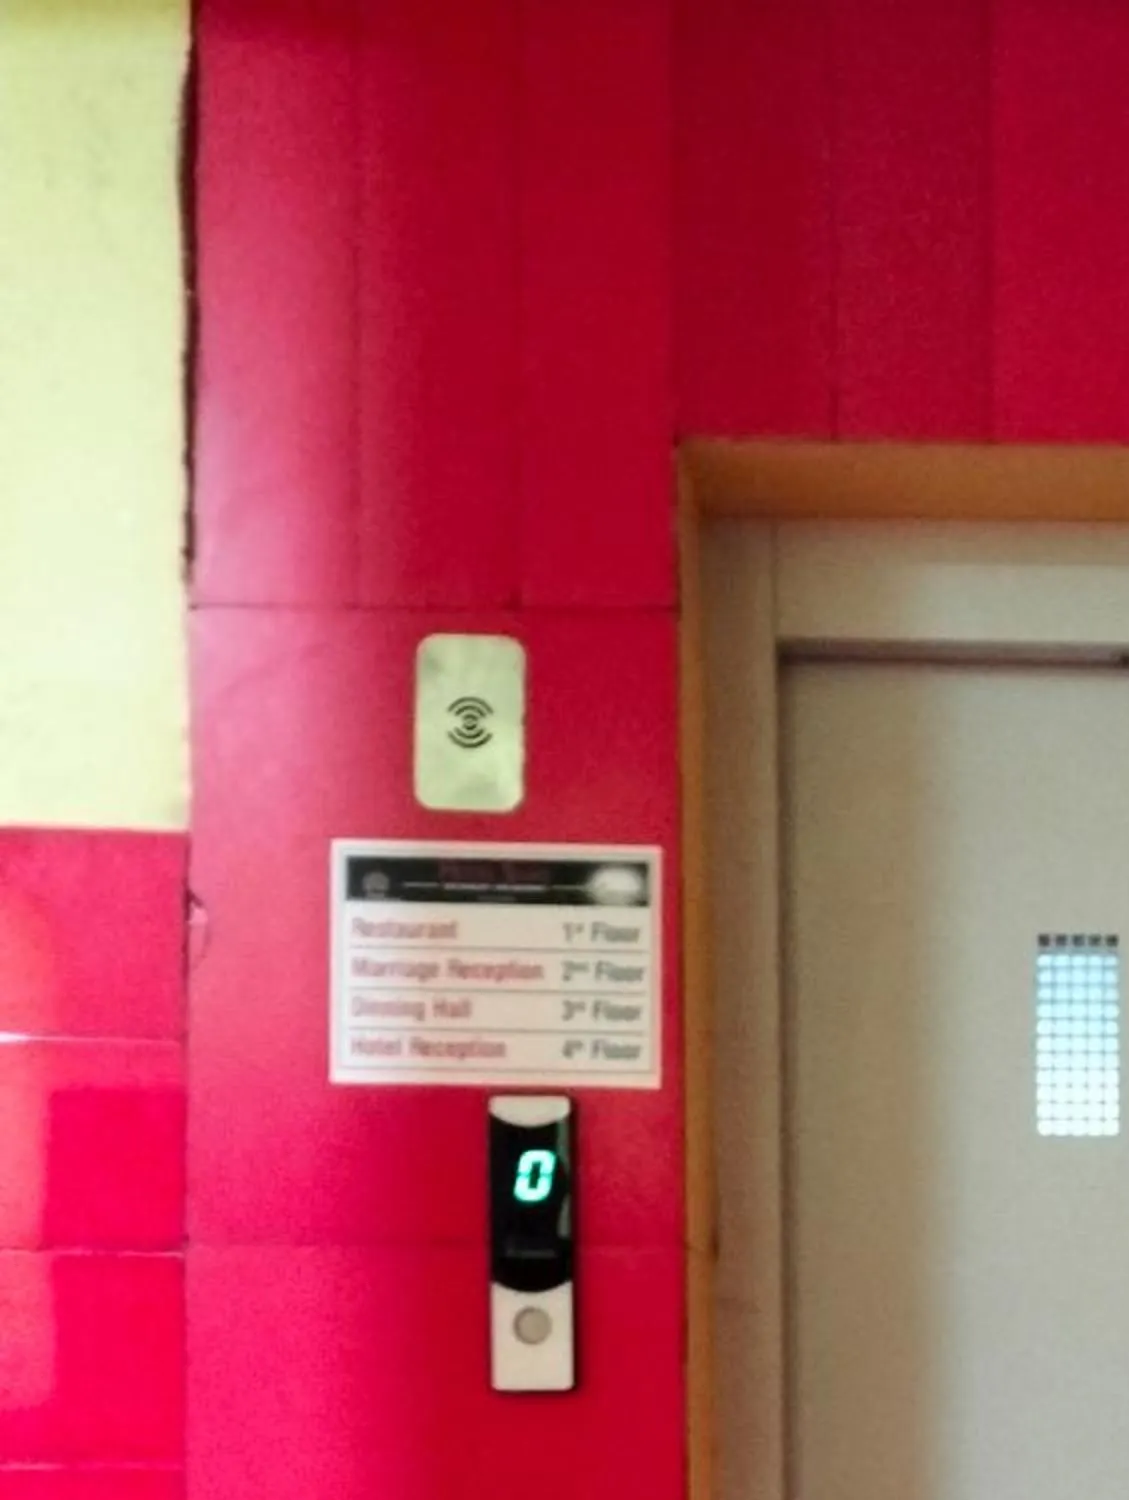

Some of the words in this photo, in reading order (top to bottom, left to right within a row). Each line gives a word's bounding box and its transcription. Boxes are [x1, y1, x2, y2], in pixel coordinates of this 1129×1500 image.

[352, 917, 459, 939] Restaurant
[591, 921, 640, 943] Floor
[352, 957, 439, 983] Marriage
[448, 959, 544, 983] Reception
[595, 960, 645, 982] Floor
[433, 997, 473, 1018] Hall
[592, 1000, 643, 1021] Floor
[351, 1036, 402, 1056] Hotel
[410, 1036, 507, 1061] Reception
[590, 1039, 642, 1060] Floor
[513, 1149, 555, 1203] 0
